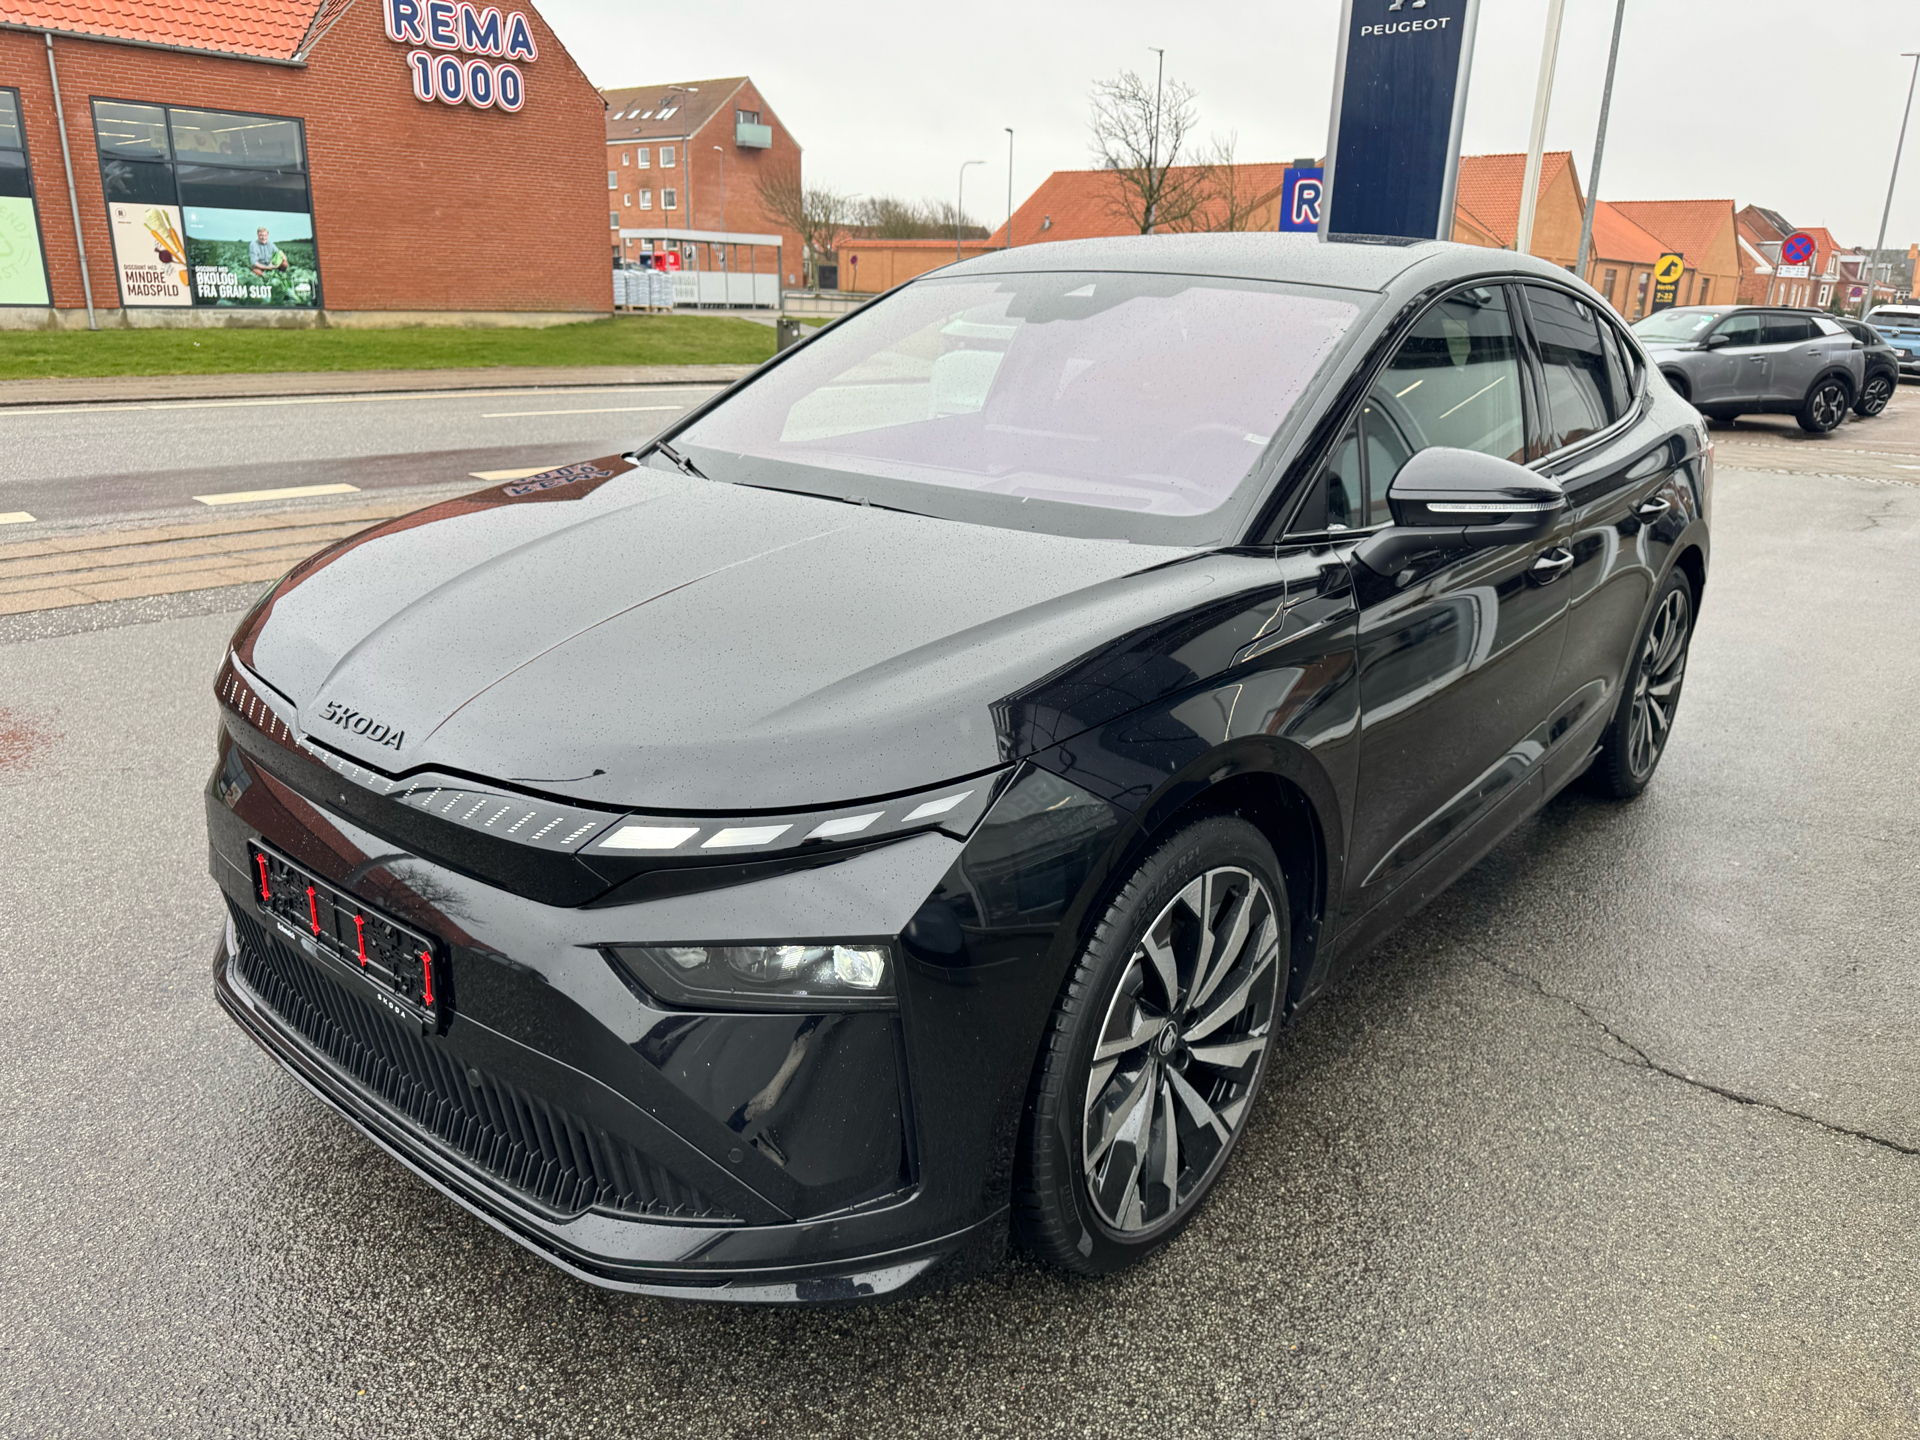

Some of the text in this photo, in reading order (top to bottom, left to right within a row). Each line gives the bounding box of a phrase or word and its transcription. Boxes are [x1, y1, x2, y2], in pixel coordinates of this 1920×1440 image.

[385, 0, 538, 62] REMA
[1360, 17, 1451, 37] PEUGEOT
[406, 49, 526, 113] 1000
[125, 271, 166, 284] MINDRE
[196, 272, 238, 286] ØKOLOGI
[127, 284, 179, 297] MADSPILD
[197, 285, 272, 298] FRA GRAM SLOT
